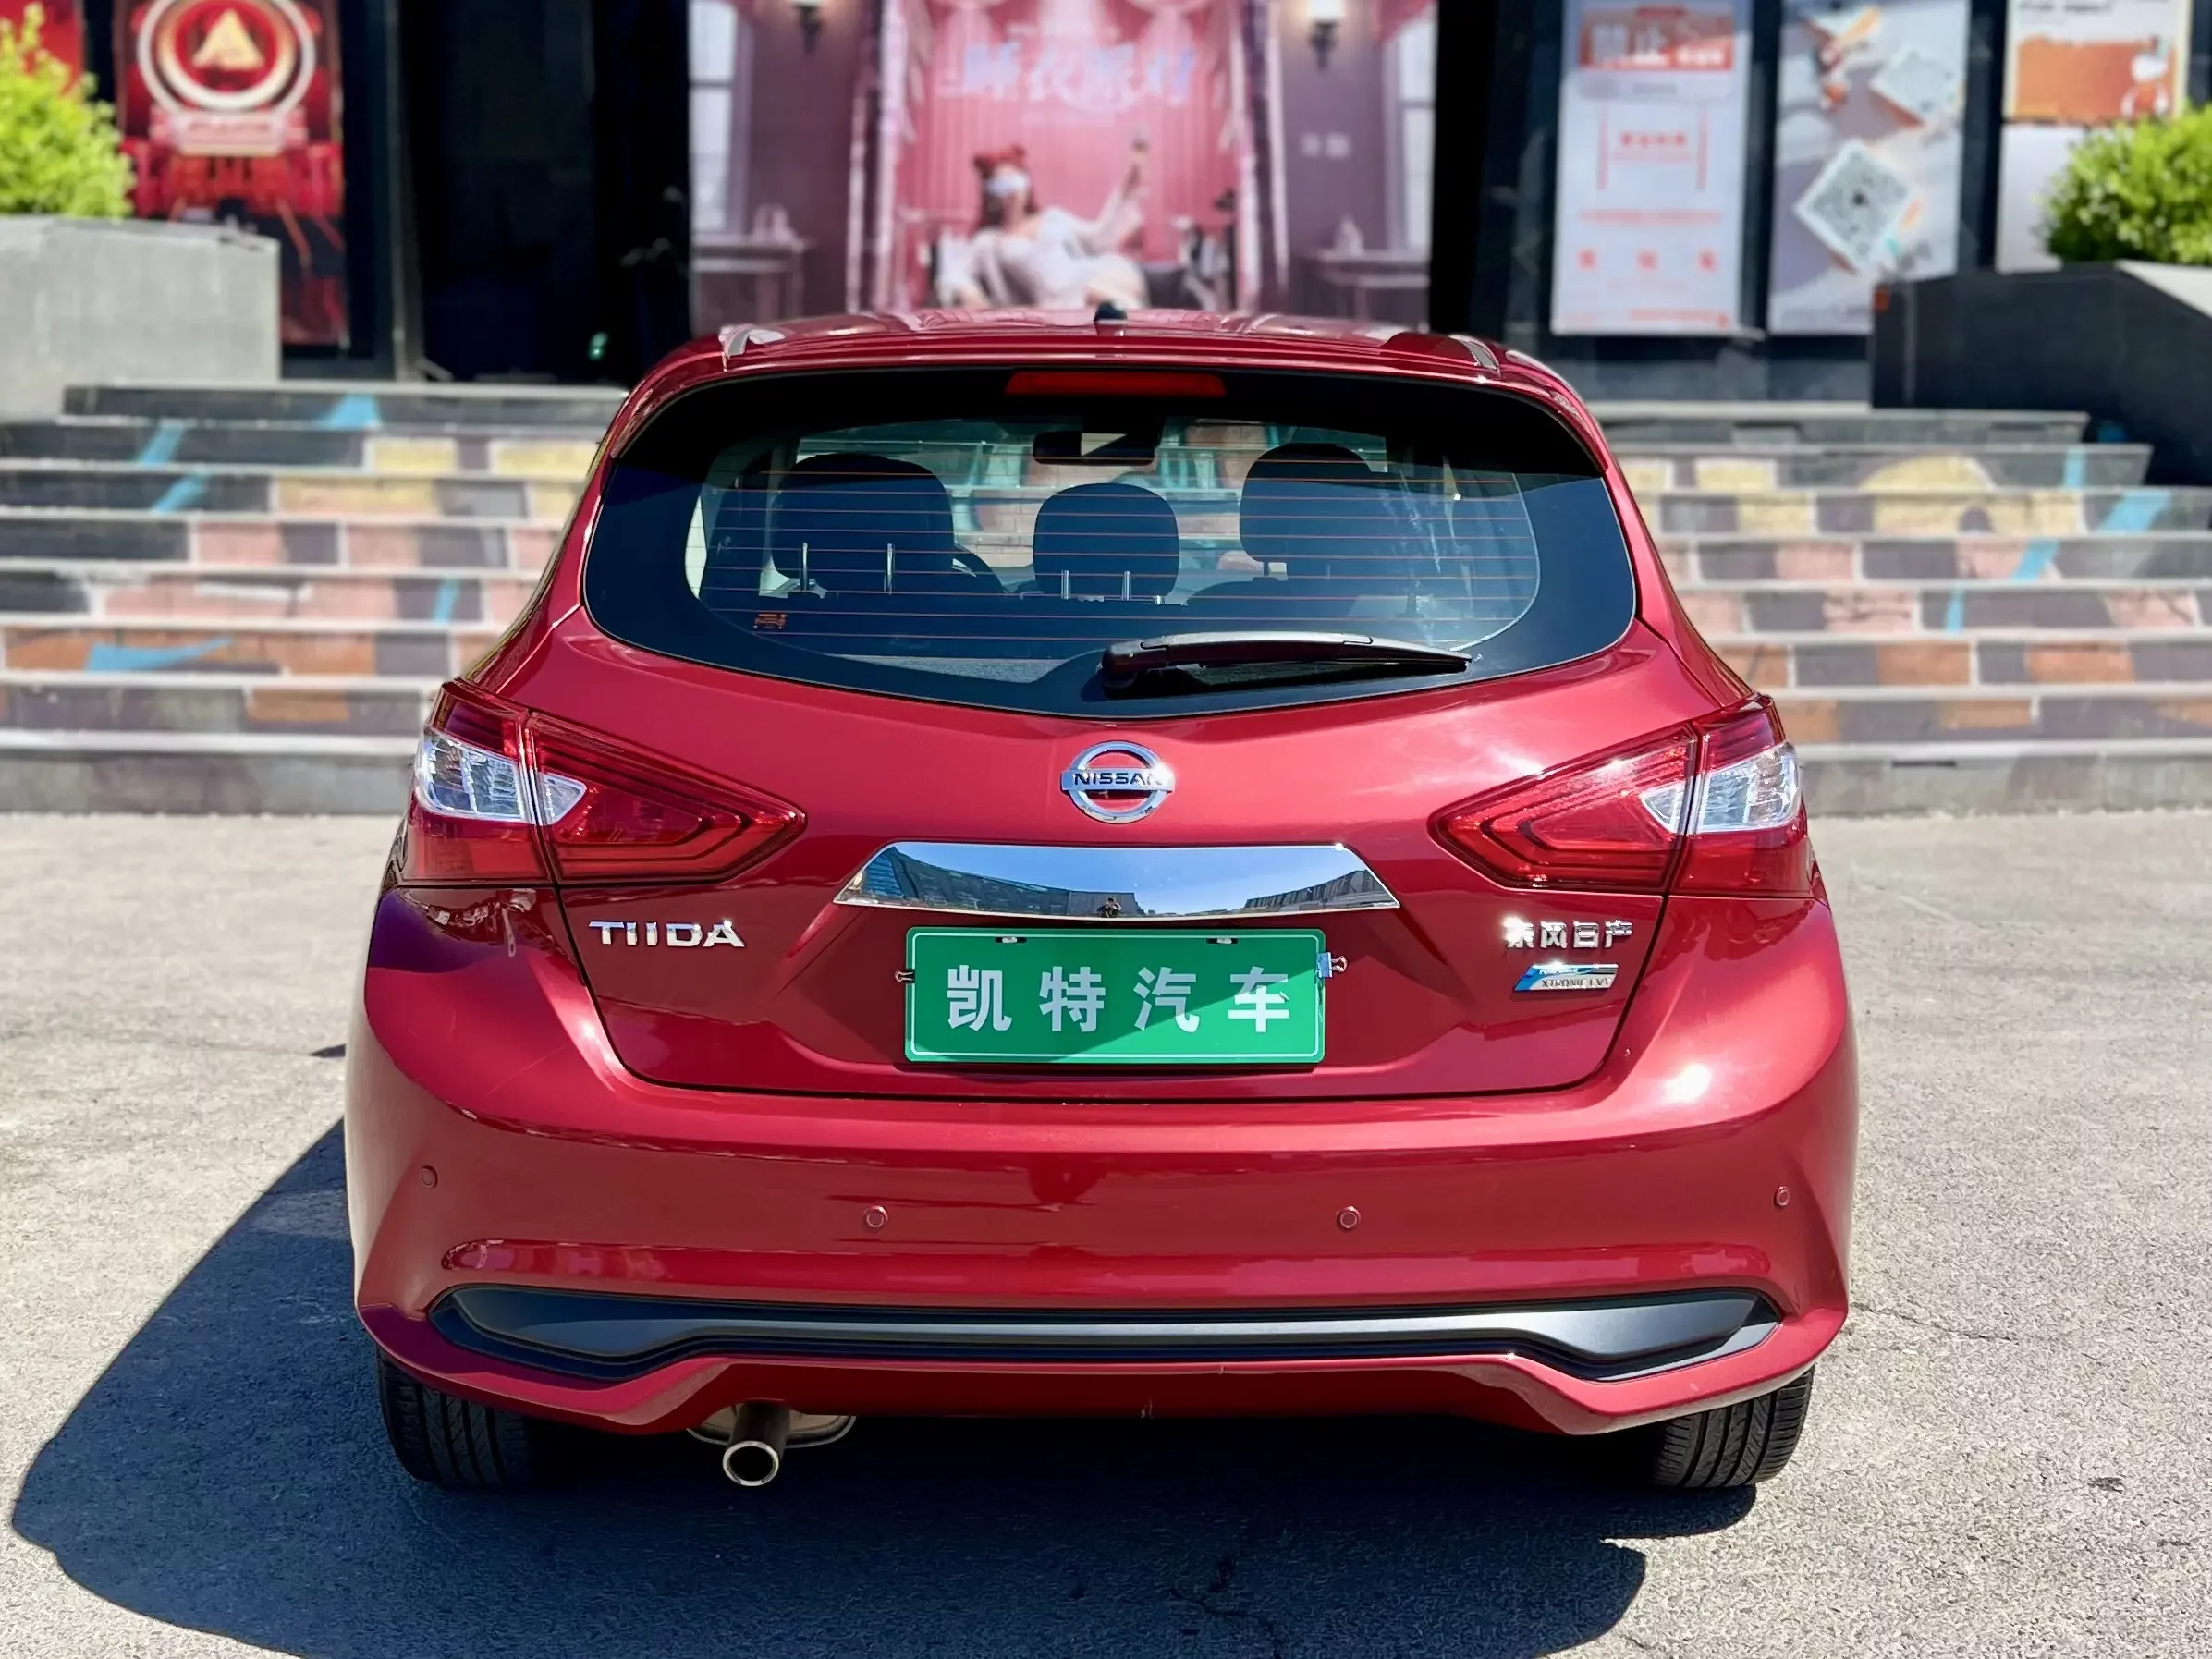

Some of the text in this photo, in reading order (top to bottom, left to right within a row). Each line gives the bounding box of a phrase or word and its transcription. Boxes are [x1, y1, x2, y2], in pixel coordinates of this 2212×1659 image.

[588, 919, 745, 948] TIIDA
[946, 964, 1291, 1033] 凯特汽车
